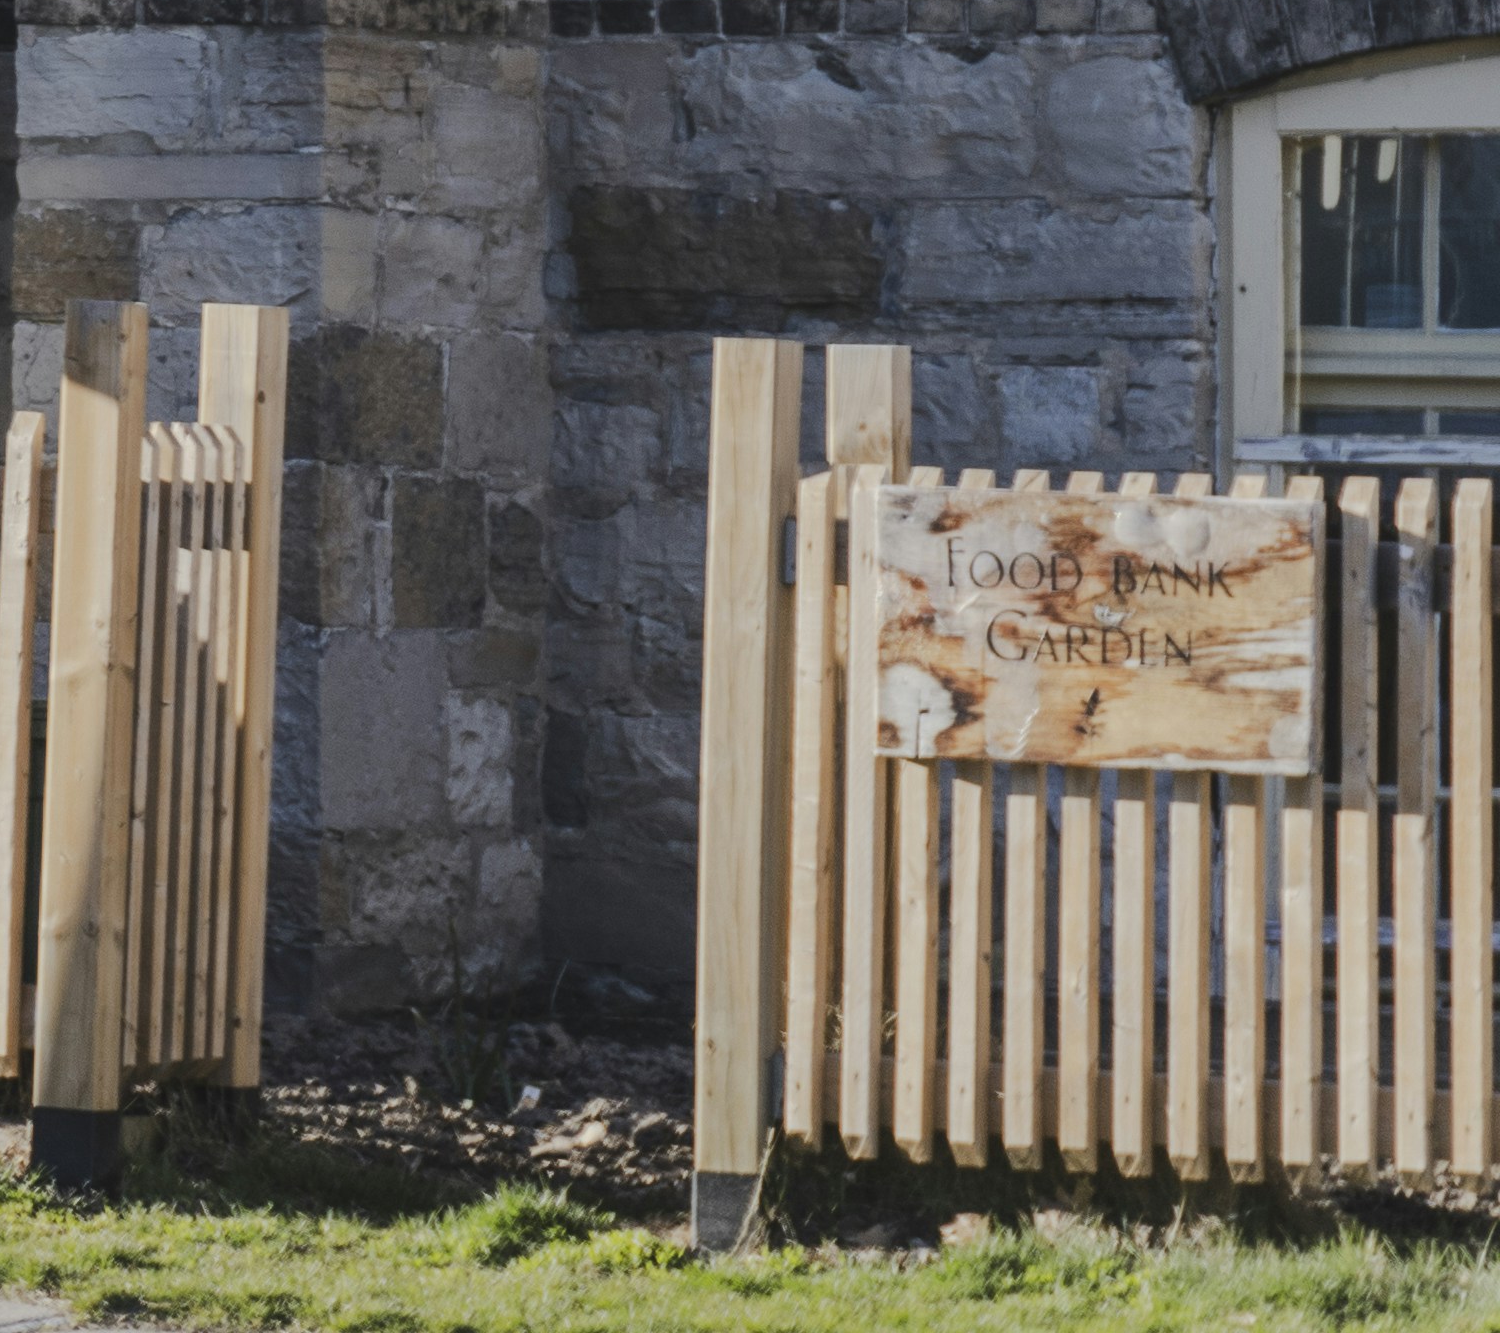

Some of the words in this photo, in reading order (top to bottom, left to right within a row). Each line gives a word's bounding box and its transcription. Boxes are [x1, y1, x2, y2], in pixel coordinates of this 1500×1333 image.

[947, 536, 1083, 592] FOOD
[1111, 554, 1234, 598] BANK
[986, 609, 1192, 667] GARDEN
